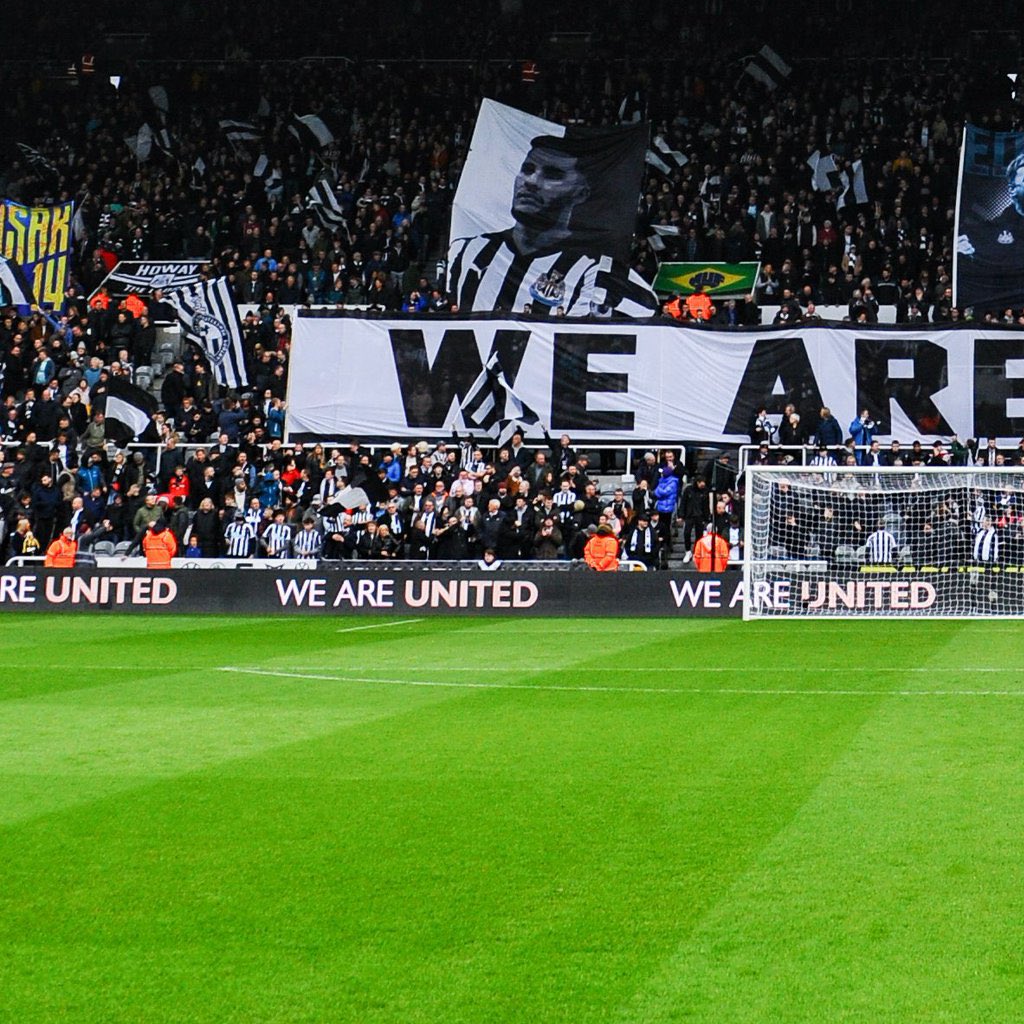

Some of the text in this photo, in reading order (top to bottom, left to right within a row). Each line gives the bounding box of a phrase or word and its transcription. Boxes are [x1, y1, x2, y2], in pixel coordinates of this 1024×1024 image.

[0, 204, 71, 266] ISAK
[33, 256, 67, 311] 14
[135, 264, 198, 276] HOWAY
[388, 328, 637, 432] WE
[46, 576, 178, 604] UNITED
[275, 578, 539, 608] WE ARE UNITED
[669, 580, 937, 609] WE ARE UNITED
